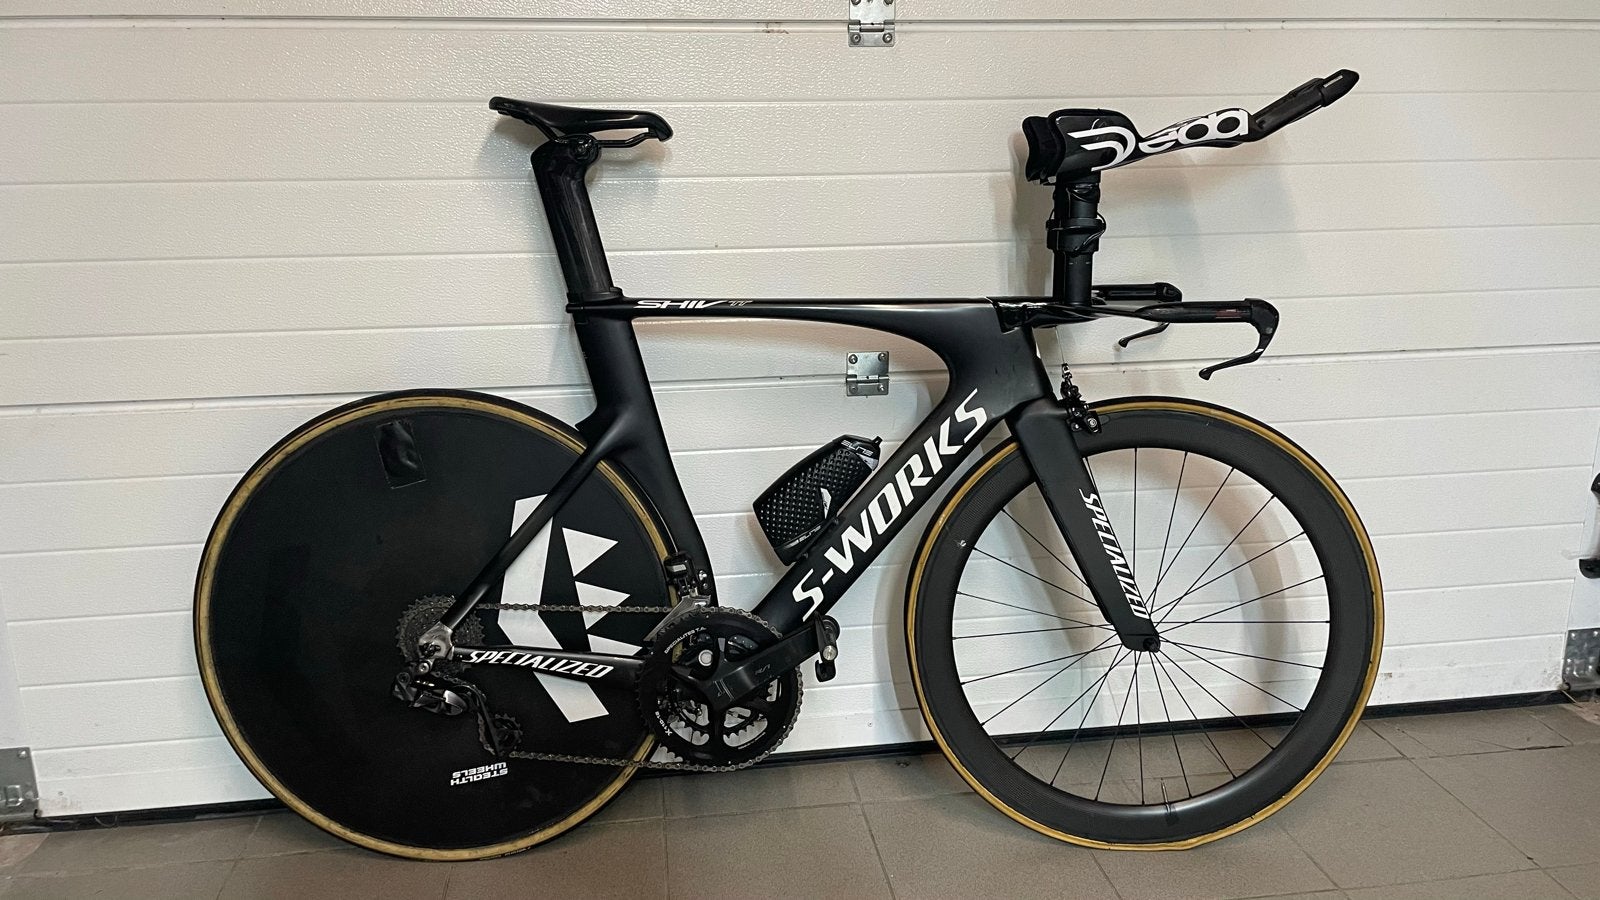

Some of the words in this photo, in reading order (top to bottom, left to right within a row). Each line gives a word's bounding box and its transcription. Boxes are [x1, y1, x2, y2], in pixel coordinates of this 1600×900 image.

[633, 300, 727, 309] SHIV
[792, 388, 988, 622] S-WORKS
[1078, 488, 1150, 620] SPECIALIZED
[462, 651, 614, 679] SPECIALIZED
[450, 768, 508, 786] STEALTH
[451, 762, 507, 779] WHEELS
